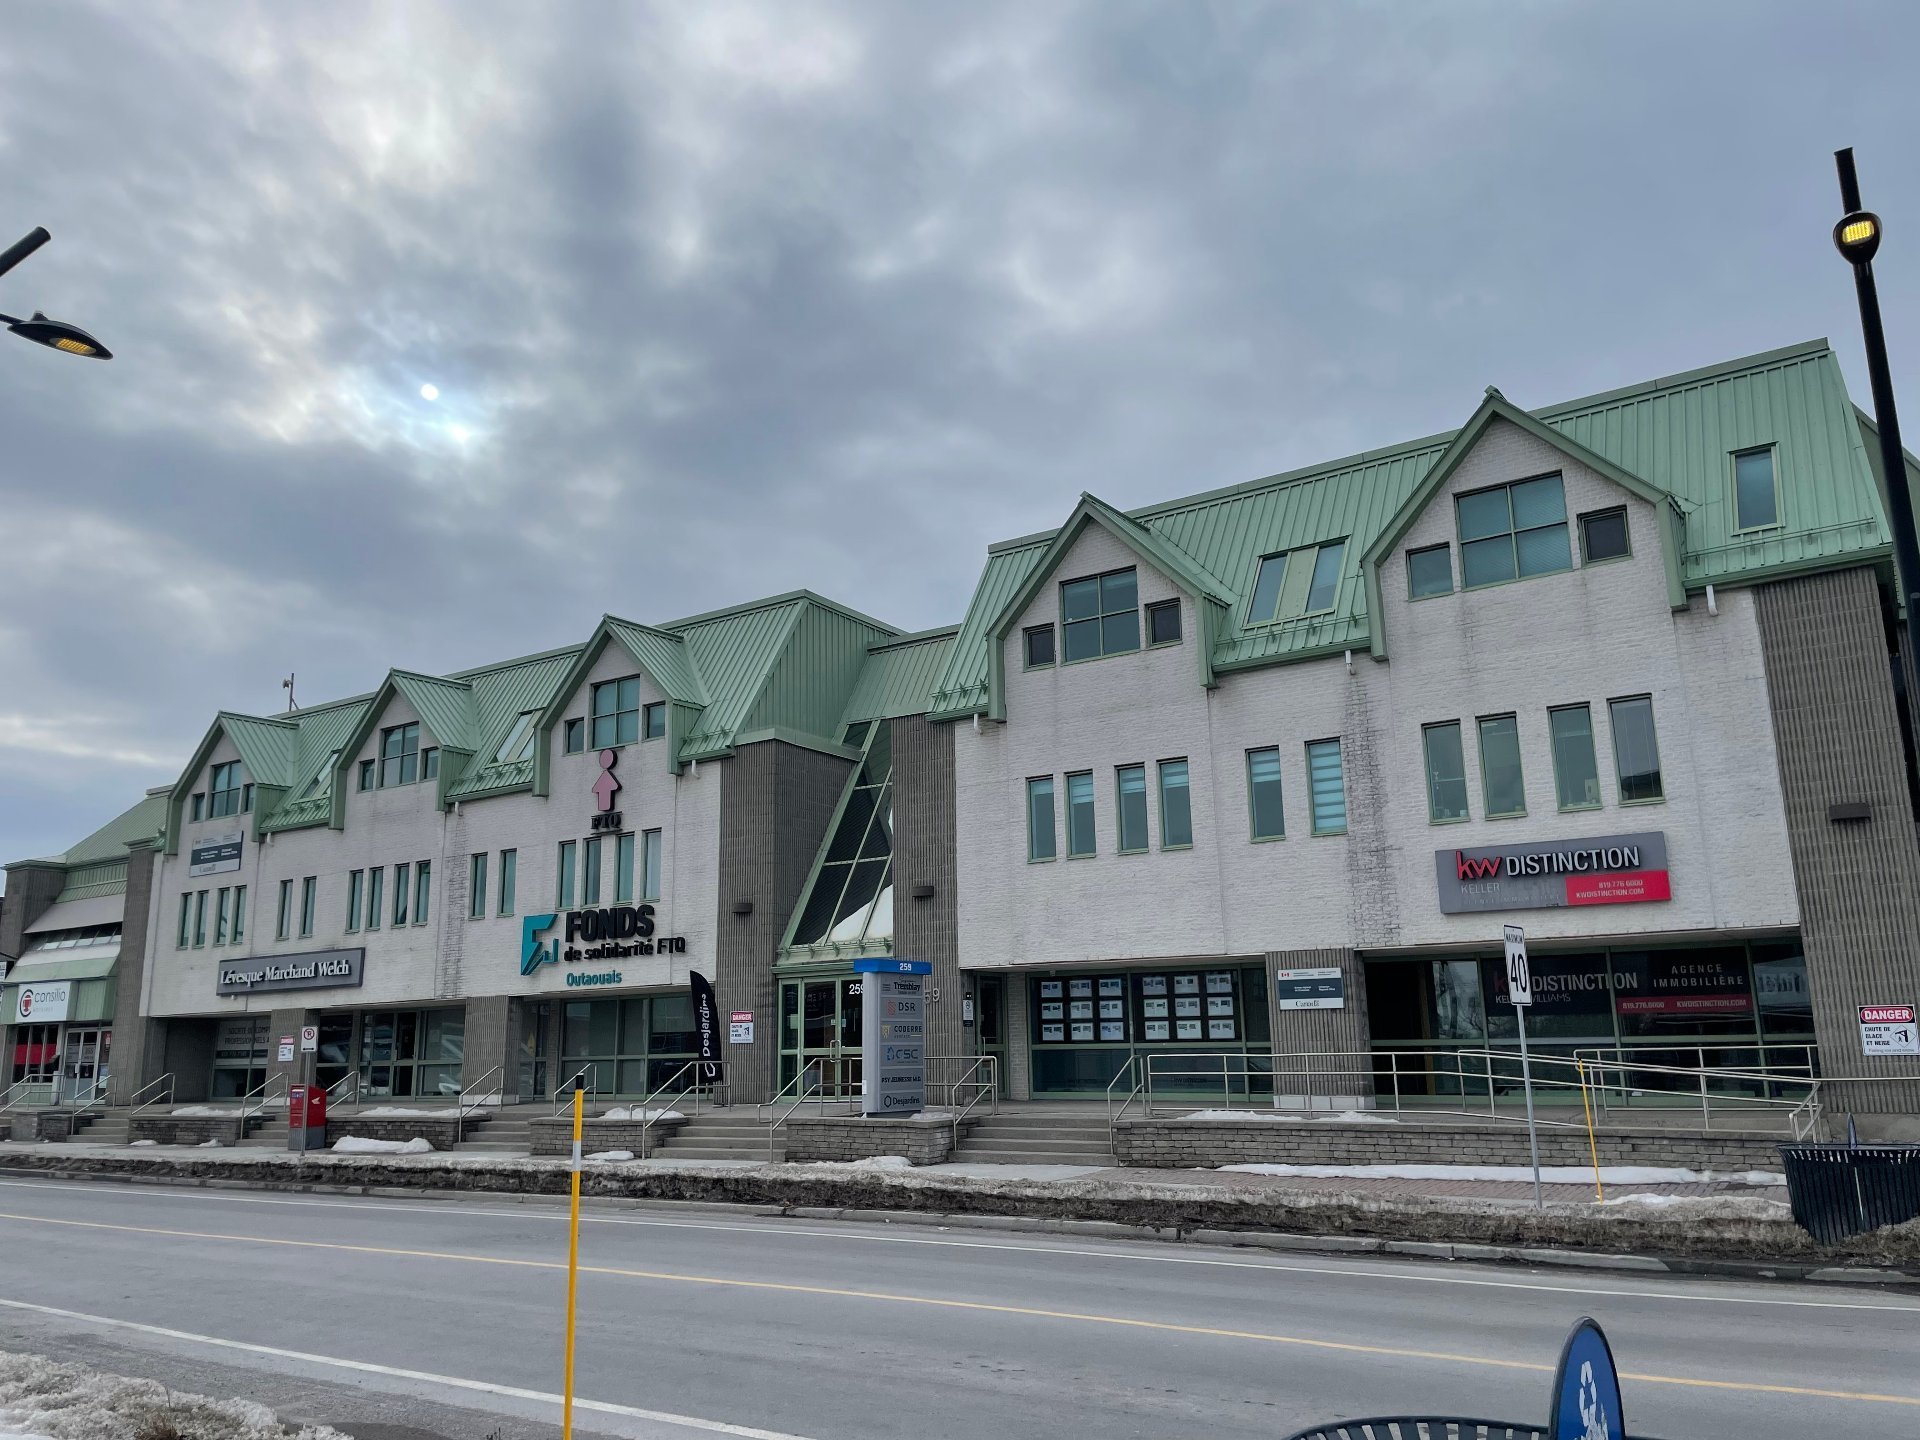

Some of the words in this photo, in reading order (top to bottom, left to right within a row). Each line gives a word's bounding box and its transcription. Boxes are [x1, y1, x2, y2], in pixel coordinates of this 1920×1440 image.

[590, 814, 622, 829] FTQ
[1456, 850, 1501, 881] kw
[1505, 846, 1640, 877] DISTINCTION
[1461, 882, 1500, 894] KELLER
[1575, 888, 1644, 898] KWDISTINCTION.COM
[565, 904, 655, 942] FONDS
[564, 946, 582, 961] de
[584, 939, 654, 959] solidarité
[657, 936, 686, 954] FTQ
[899, 962, 912, 971] 259
[1671, 964, 1723, 974] AGENCE
[220, 969, 263, 987] Lévesque
[265, 962, 316, 980] Marchand
[318, 959, 350, 976] Welch
[566, 970, 622, 986] Outaouais
[1511, 952, 1527, 993] 40
[893, 981, 921, 991] Tremblay
[1532, 972, 1638, 992] DISTINCTION
[1653, 975, 1744, 988] IMMOBILIÈRE
[34, 987, 66, 1003] consilio
[924, 987, 940, 1004] 59
[1495, 995, 1512, 1004] KEL
[1531, 993, 1571, 1003] ILLIAMS
[898, 1002, 916, 1011] DSR
[1676, 999, 1746, 1008] KWDISTINCTION.COM
[732, 1013, 752, 1021] DANGER
[1864, 1009, 1910, 1020] DANGER
[894, 1025, 922, 1033] CODERRE
[895, 1049, 918, 1059] CSC
[893, 1096, 920, 1106] Desjardins
